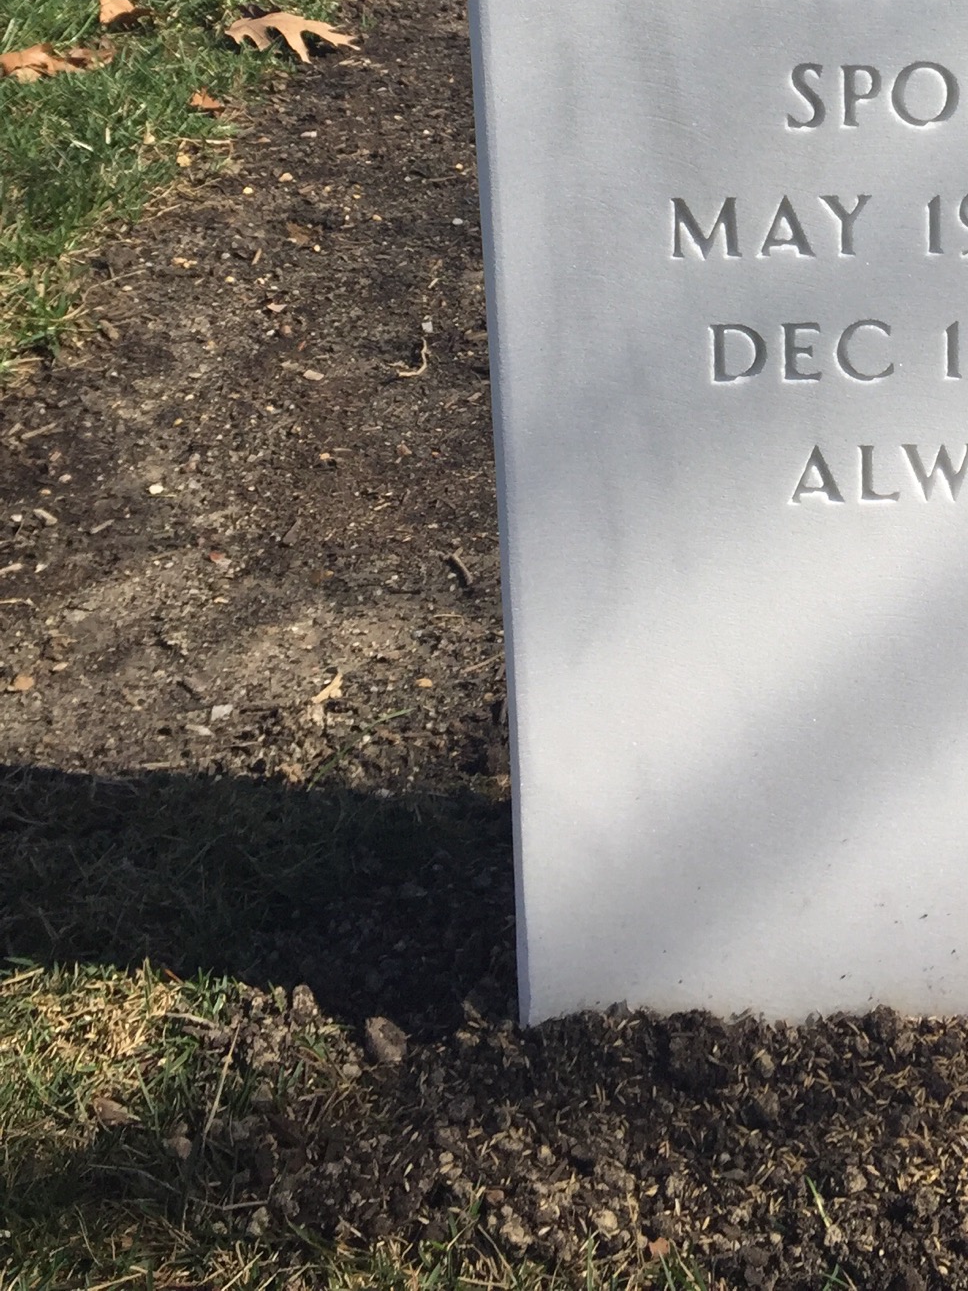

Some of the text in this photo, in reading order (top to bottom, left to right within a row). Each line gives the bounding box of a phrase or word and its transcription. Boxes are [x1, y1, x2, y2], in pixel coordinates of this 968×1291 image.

[669, 194, 872, 259] MAY
[708, 319, 895, 382] DEC
[944, 320, 961, 379] 1
